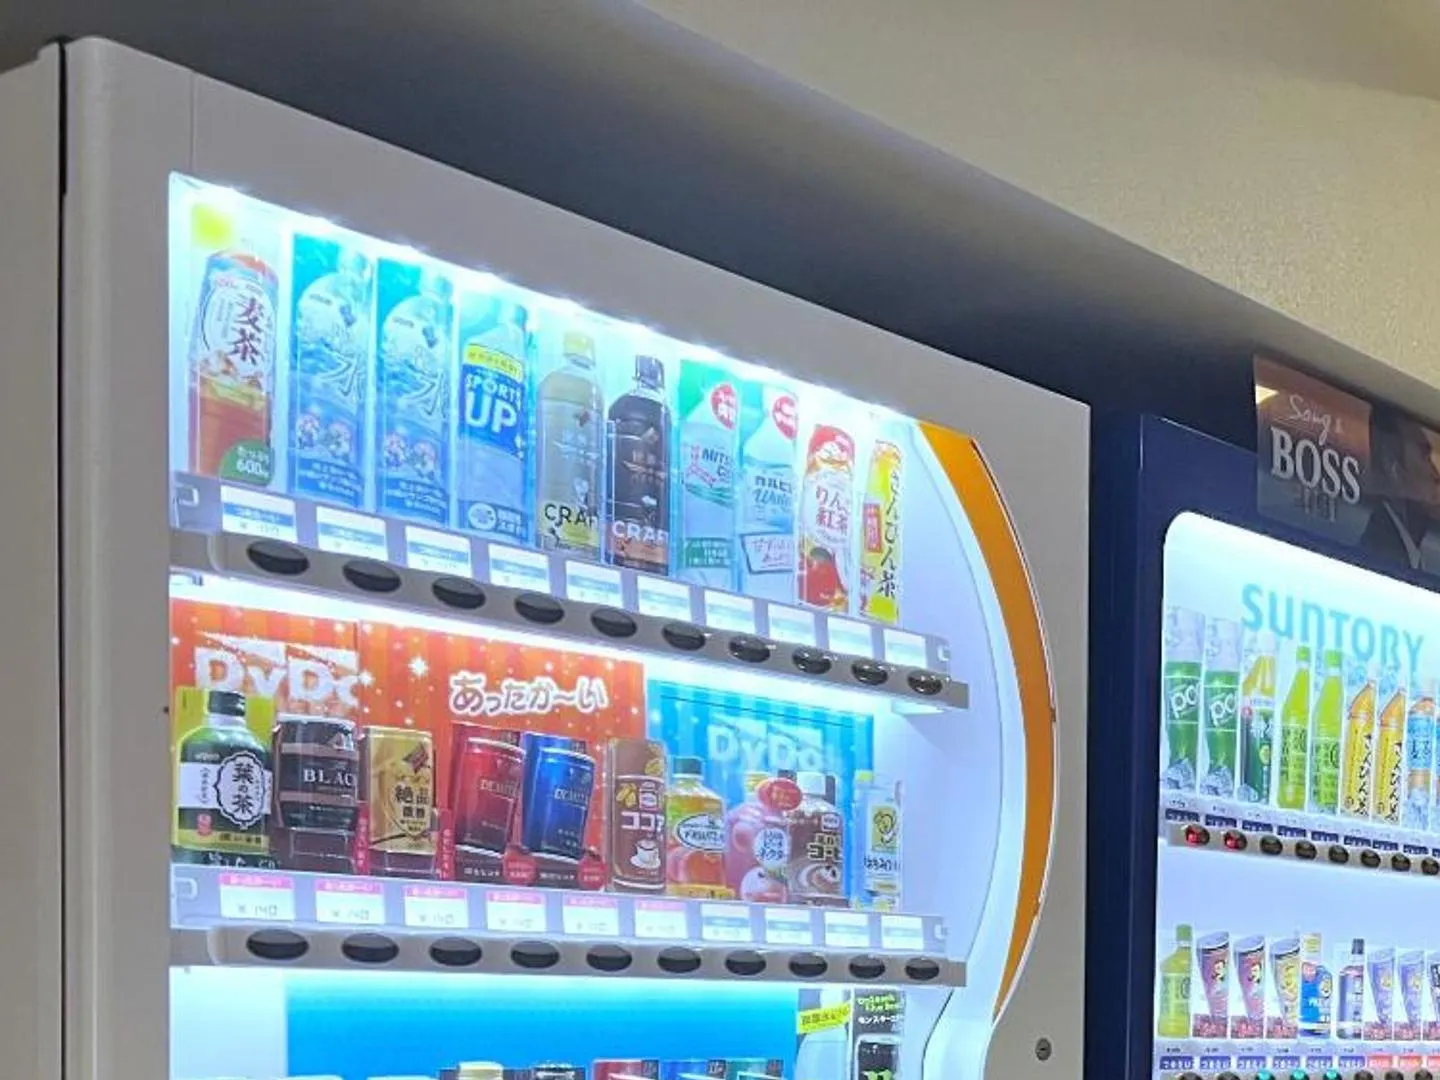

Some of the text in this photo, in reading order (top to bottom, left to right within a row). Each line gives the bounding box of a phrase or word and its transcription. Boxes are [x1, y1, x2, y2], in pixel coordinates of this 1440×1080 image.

[465, 391, 518, 434] UP
[1270, 425, 1361, 505] BOSS
[1242, 584, 1424, 671] SUNTORY
[231, 762, 254, 815] 葉の茶
